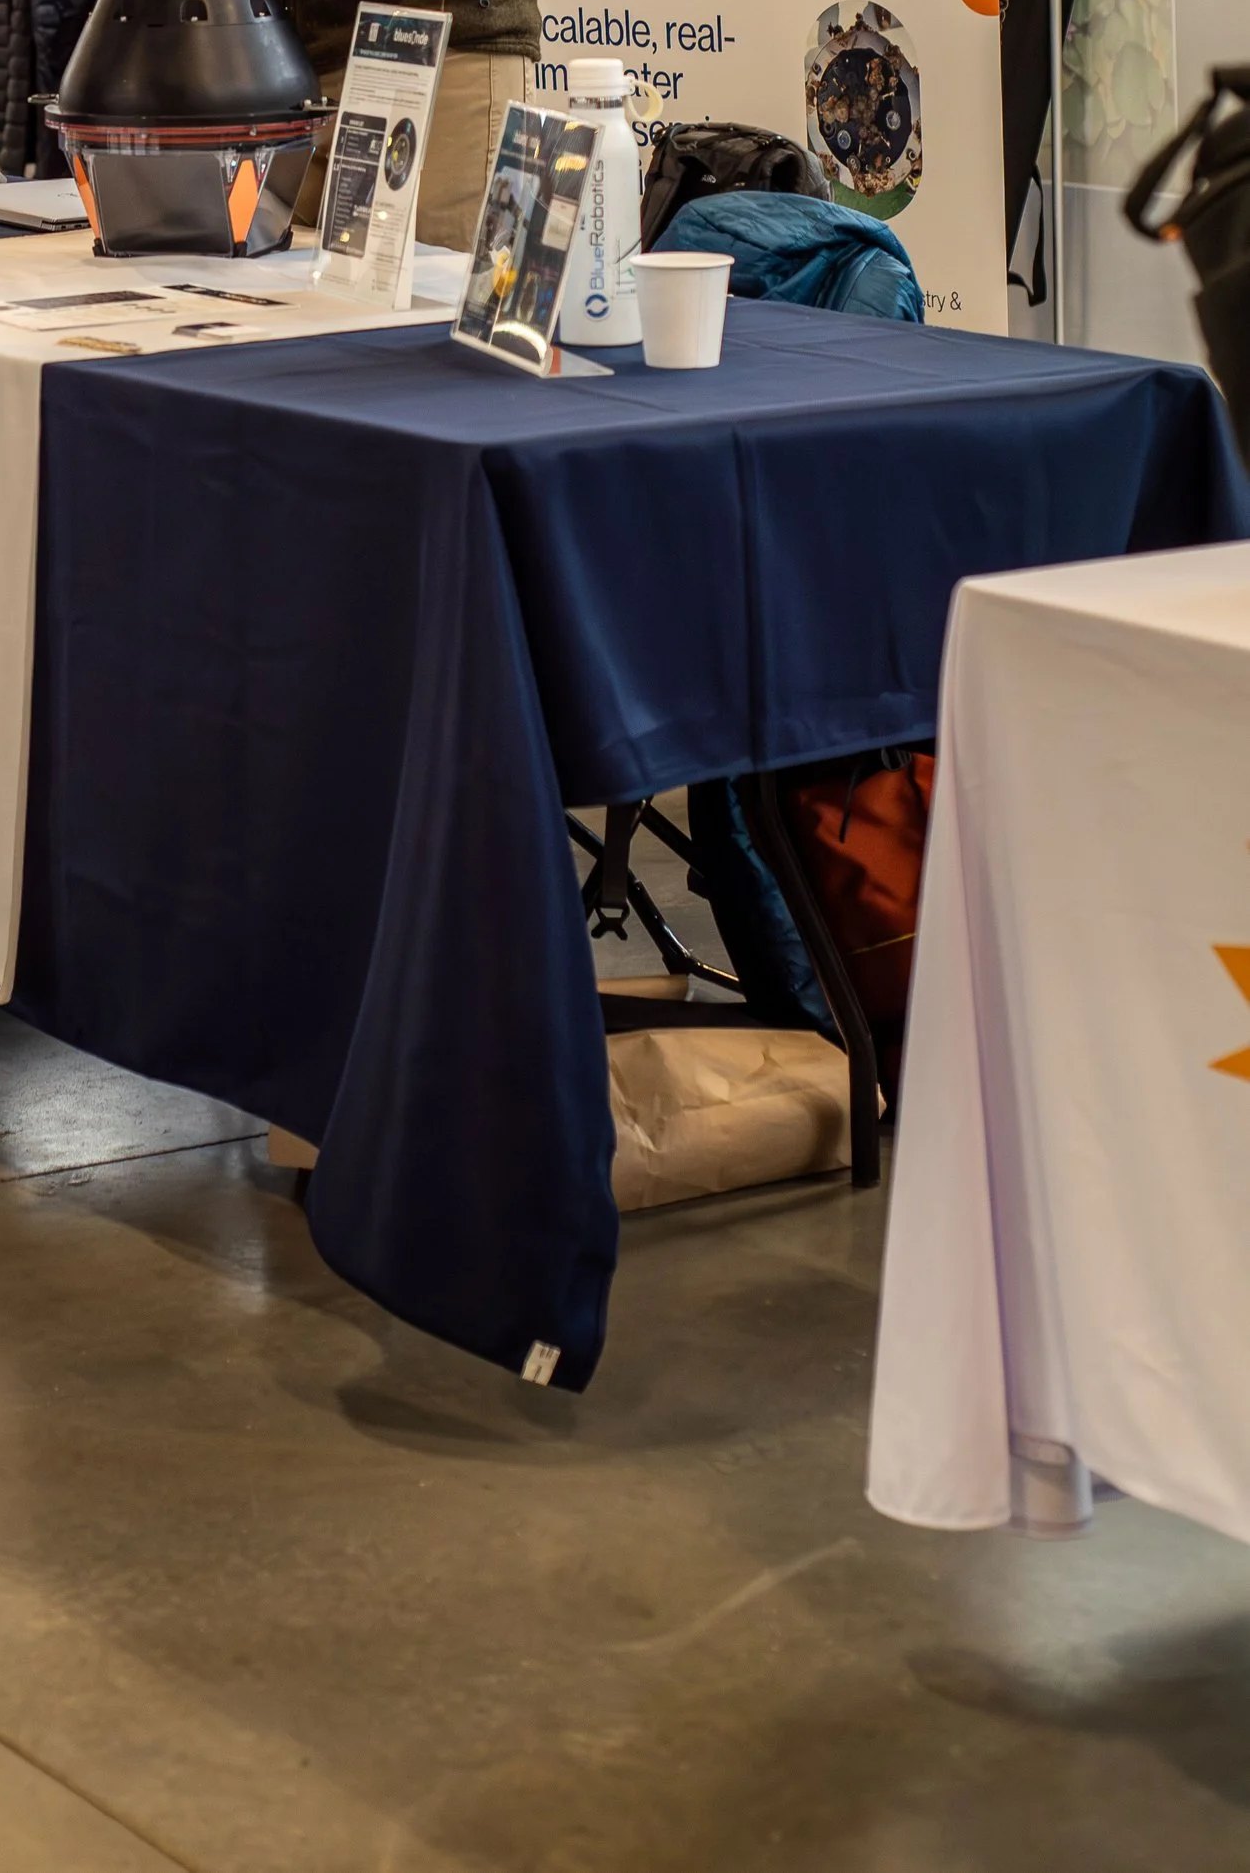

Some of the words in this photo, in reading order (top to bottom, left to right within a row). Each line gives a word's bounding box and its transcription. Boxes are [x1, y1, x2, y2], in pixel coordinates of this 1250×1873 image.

[542, 7, 658, 55] calable,
[665, 15, 735, 53] real-
[623, 63, 684, 100] ater
[589, 159, 606, 290] BlueRobotics
[950, 291, 962, 311] &
